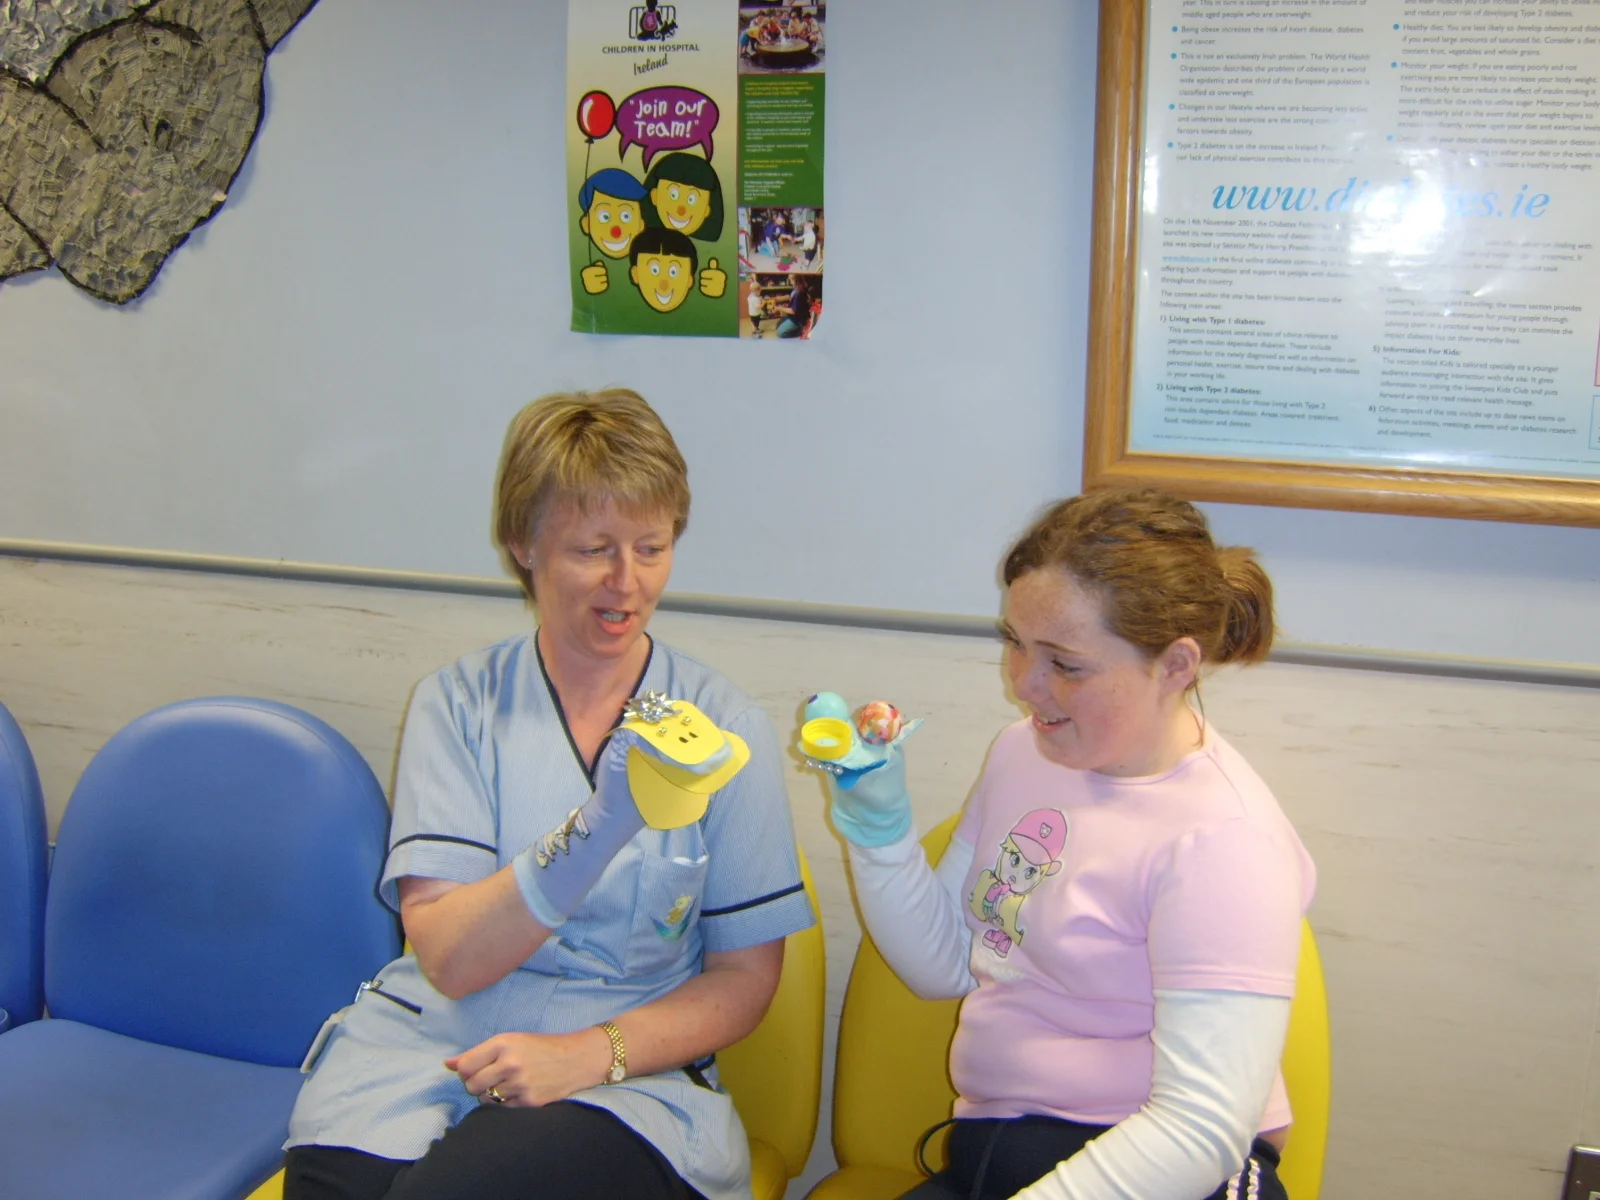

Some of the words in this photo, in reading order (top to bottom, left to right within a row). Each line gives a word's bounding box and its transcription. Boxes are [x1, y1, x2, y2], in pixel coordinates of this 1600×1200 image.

[602, 46, 644, 54] CHILDREN
[646, 45, 656, 53] IN
[659, 43, 700, 52] HOSPITAL
[633, 53, 669, 76] Ireland
